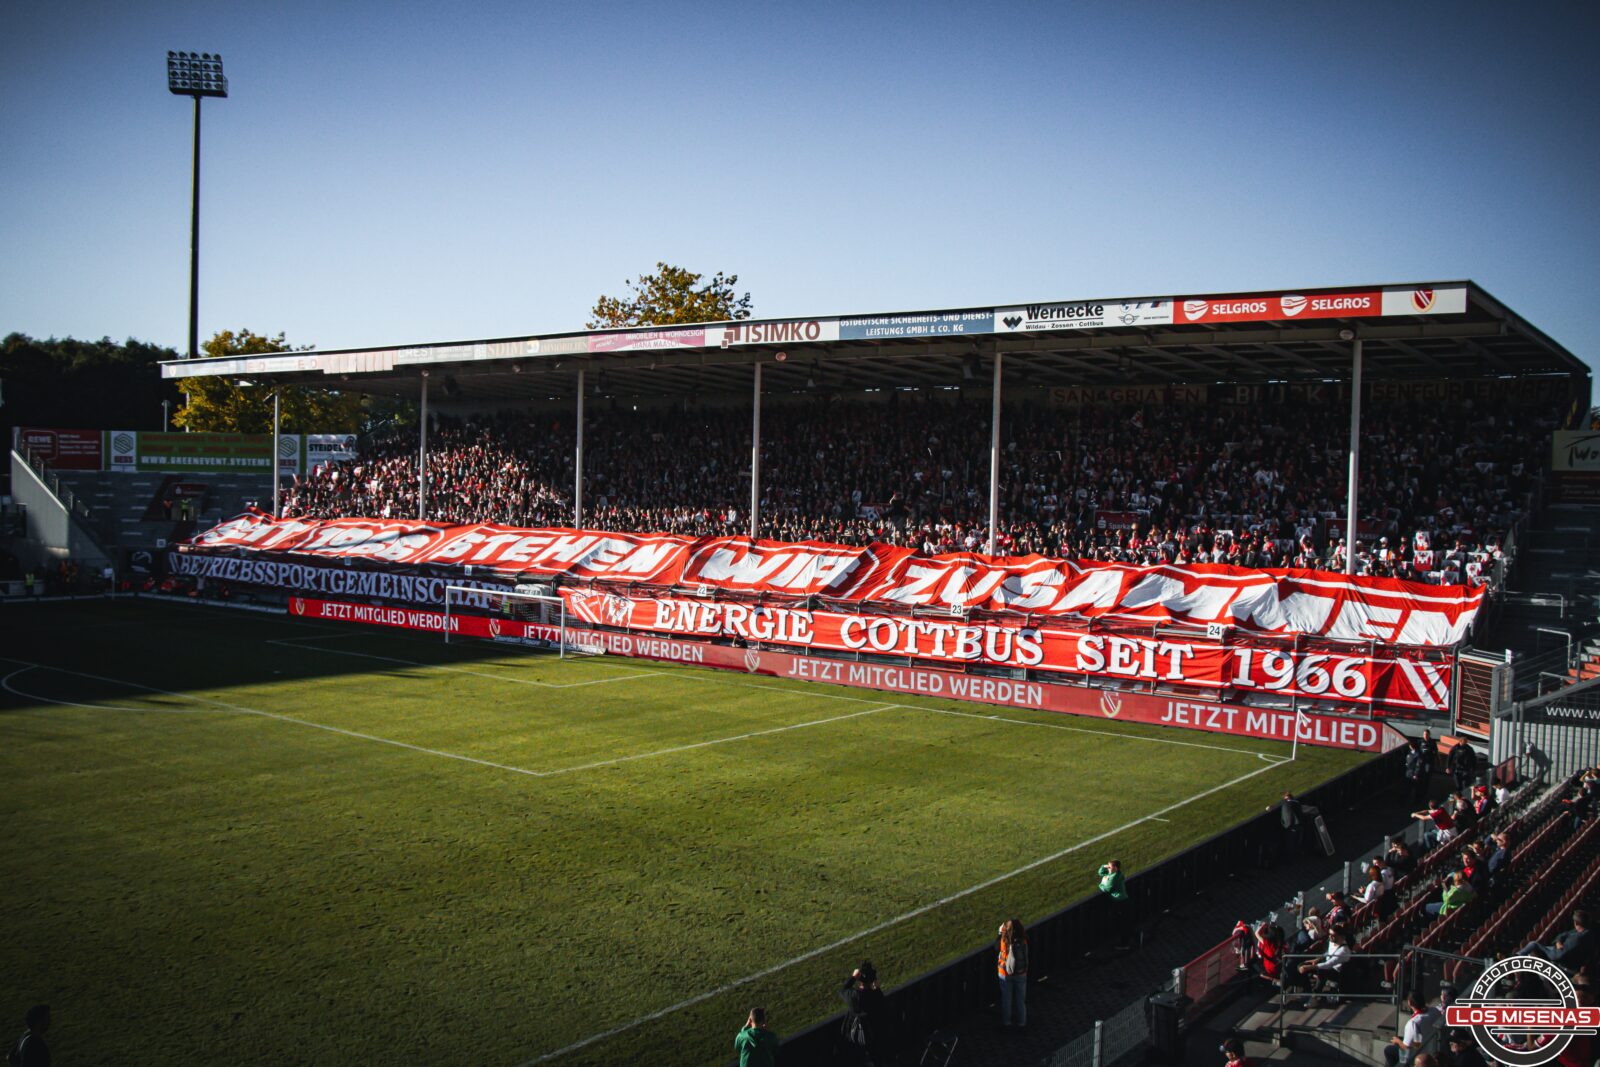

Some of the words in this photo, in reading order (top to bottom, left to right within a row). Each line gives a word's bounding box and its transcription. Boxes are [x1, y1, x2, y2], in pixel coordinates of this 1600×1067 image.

[1026, 302, 1104, 320] Wernecke
[1212, 302, 1267, 315] SELGROS
[1311, 297, 1370, 310] SELGROS
[841, 317, 889, 327] OSTDEUTSCHE
[943, 313, 960, 322] UND
[962, 312, 993, 321] DIENST-
[625, 330, 658, 340] IMMOBILIEN
[665, 329, 704, 339] WOHNDESIGN
[745, 320, 820, 343] ISIMKO
[866, 326, 904, 336] LEISTUNGS
[906, 325, 928, 334] GMBH
[930, 325, 936, 333] &
[937, 324, 950, 333] CO.
[953, 323, 964, 332] KG
[141, 455, 271, 467] WWW.GREENEVENT.SYSTEMS
[699, 547, 862, 589] WIR
[951, 603, 962, 615] 23
[319, 602, 352, 619] JETZT
[354, 606, 406, 626] MITGLIED
[407, 613, 460, 633] WERDEN
[1208, 625, 1220, 636] 24
[523, 624, 561, 642] JETZT
[564, 628, 632, 653] MITGLIED
[636, 638, 703, 663] WERDEN
[653, 600, 815, 645] ENERGIE
[840, 614, 1044, 666] COTTBUS
[1076, 635, 1195, 680] SEIT
[1232, 648, 1367, 698] 1966
[788, 658, 844, 678] JETZT
[849, 664, 943, 693] MITGLIED
[949, 676, 1043, 706] WERDEN
[1161, 701, 1238, 731] JETZT
[1245, 710, 1377, 747] MITGLIED
